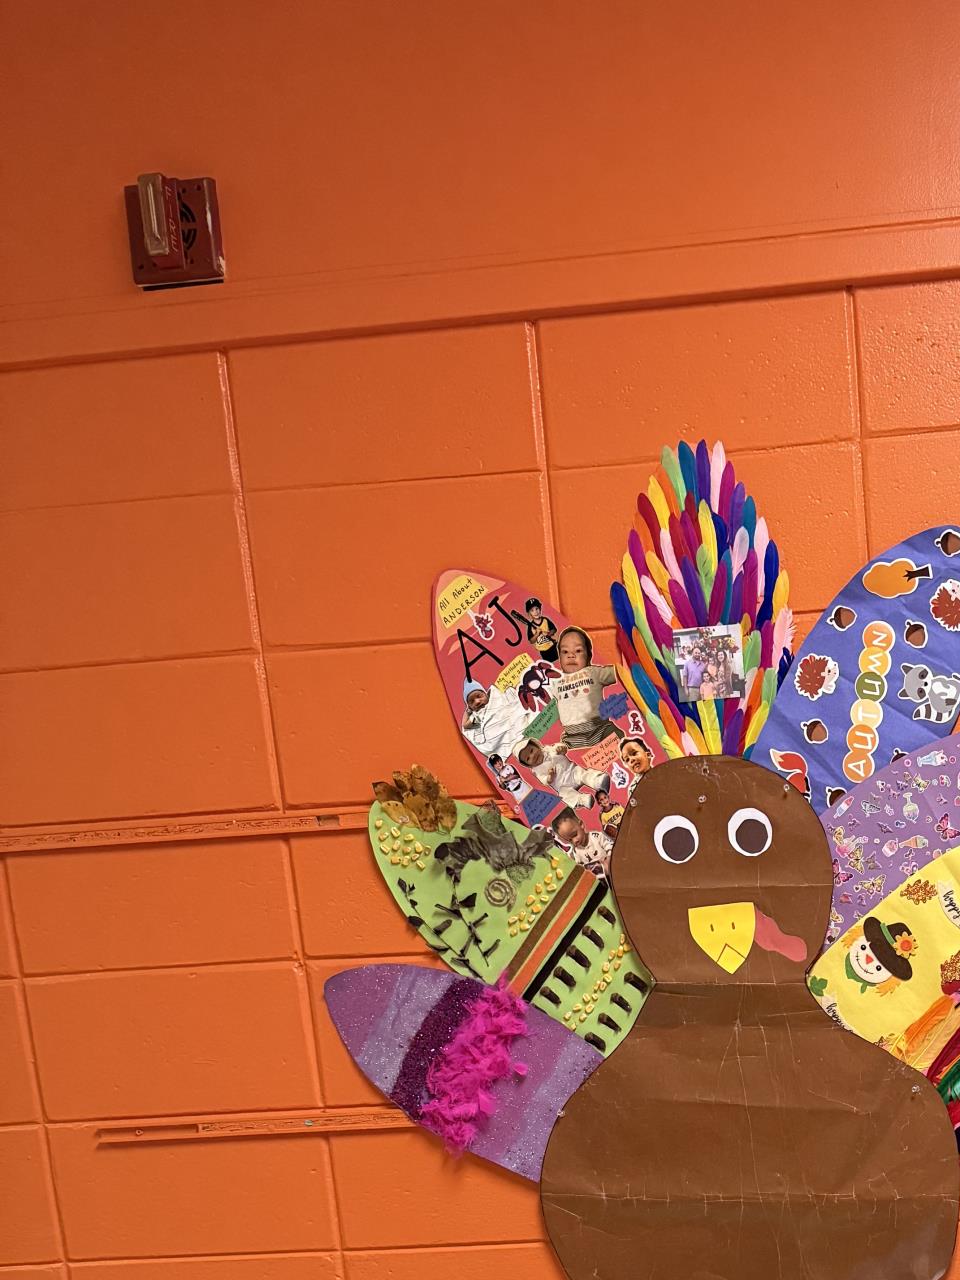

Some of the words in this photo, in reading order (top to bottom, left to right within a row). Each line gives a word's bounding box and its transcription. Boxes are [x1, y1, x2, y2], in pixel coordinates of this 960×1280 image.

[439, 598, 450, 611] All
[452, 578, 473, 599] About
[443, 585, 485, 625] ANDERSON
[847, 629, 889, 778] AUTUMN
